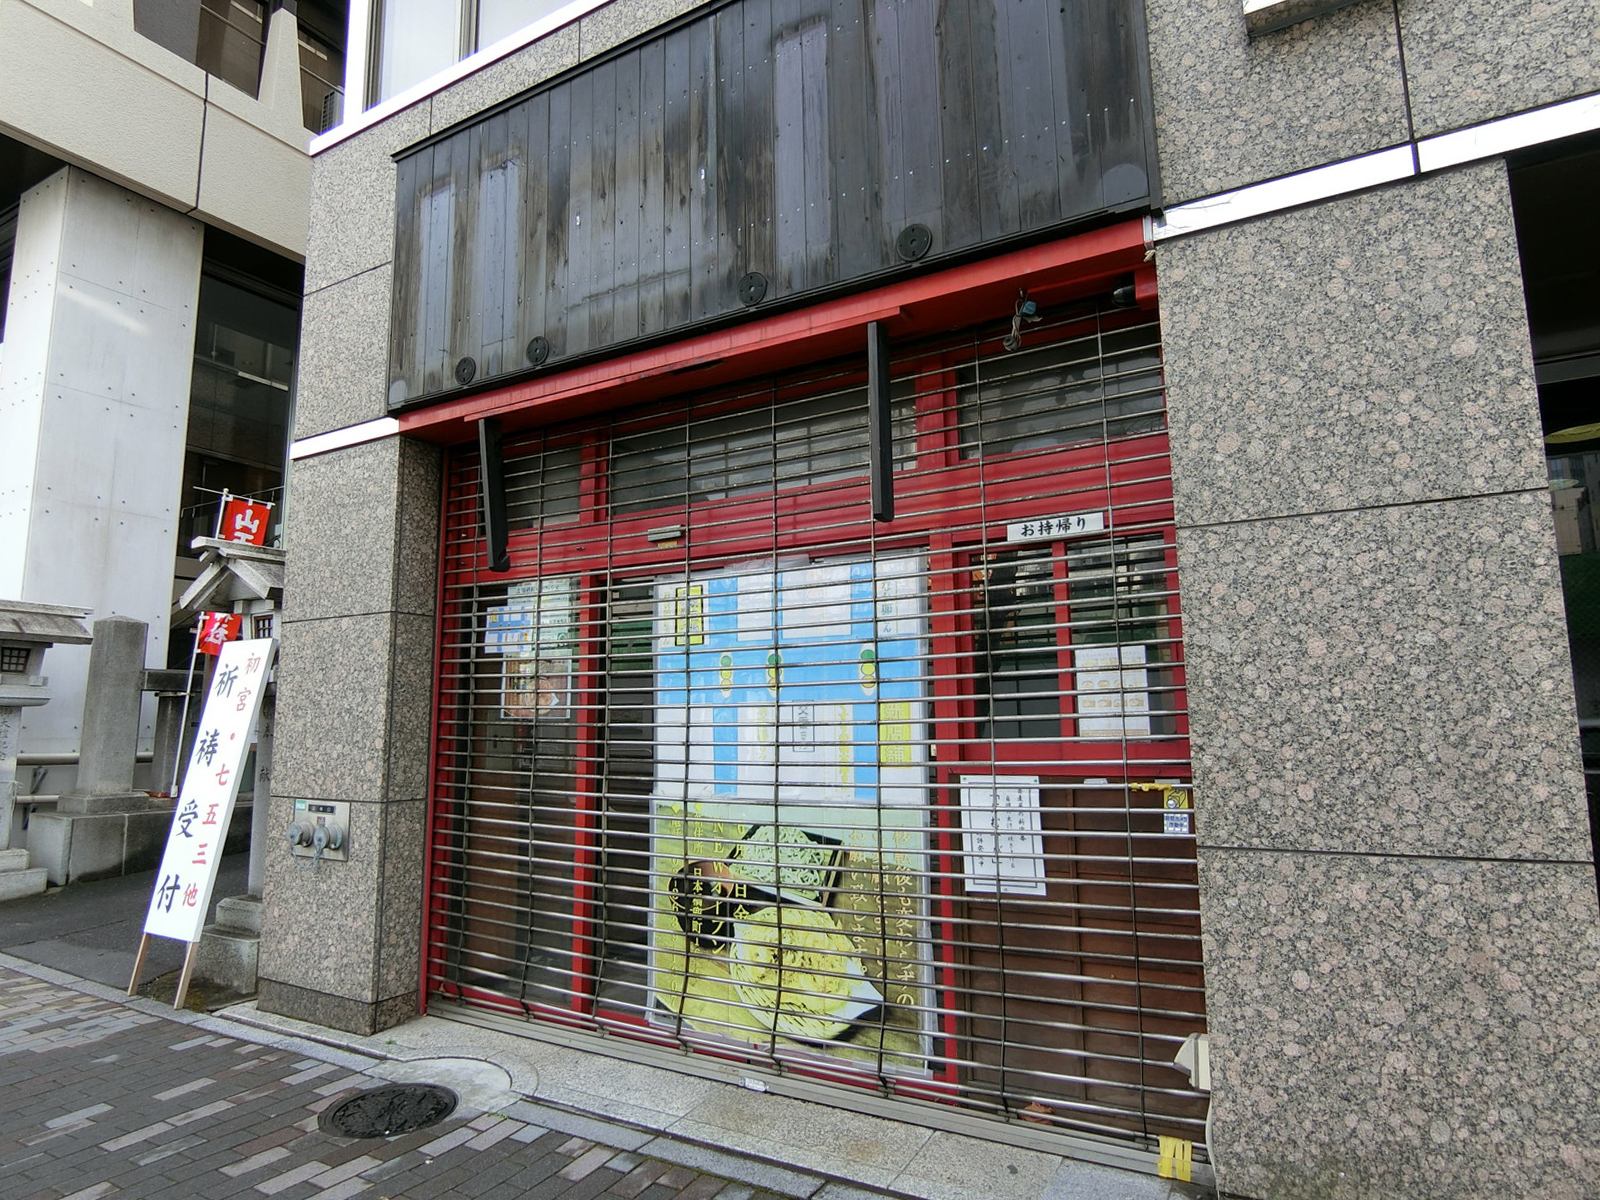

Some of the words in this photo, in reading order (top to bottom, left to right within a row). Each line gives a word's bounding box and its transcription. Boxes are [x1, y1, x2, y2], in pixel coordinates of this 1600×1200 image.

[1020, 516, 1088, 537] お持帰り
[157, 664, 240, 914] 祈祷受付
[183, 653, 261, 907] 初宮・七五三他
